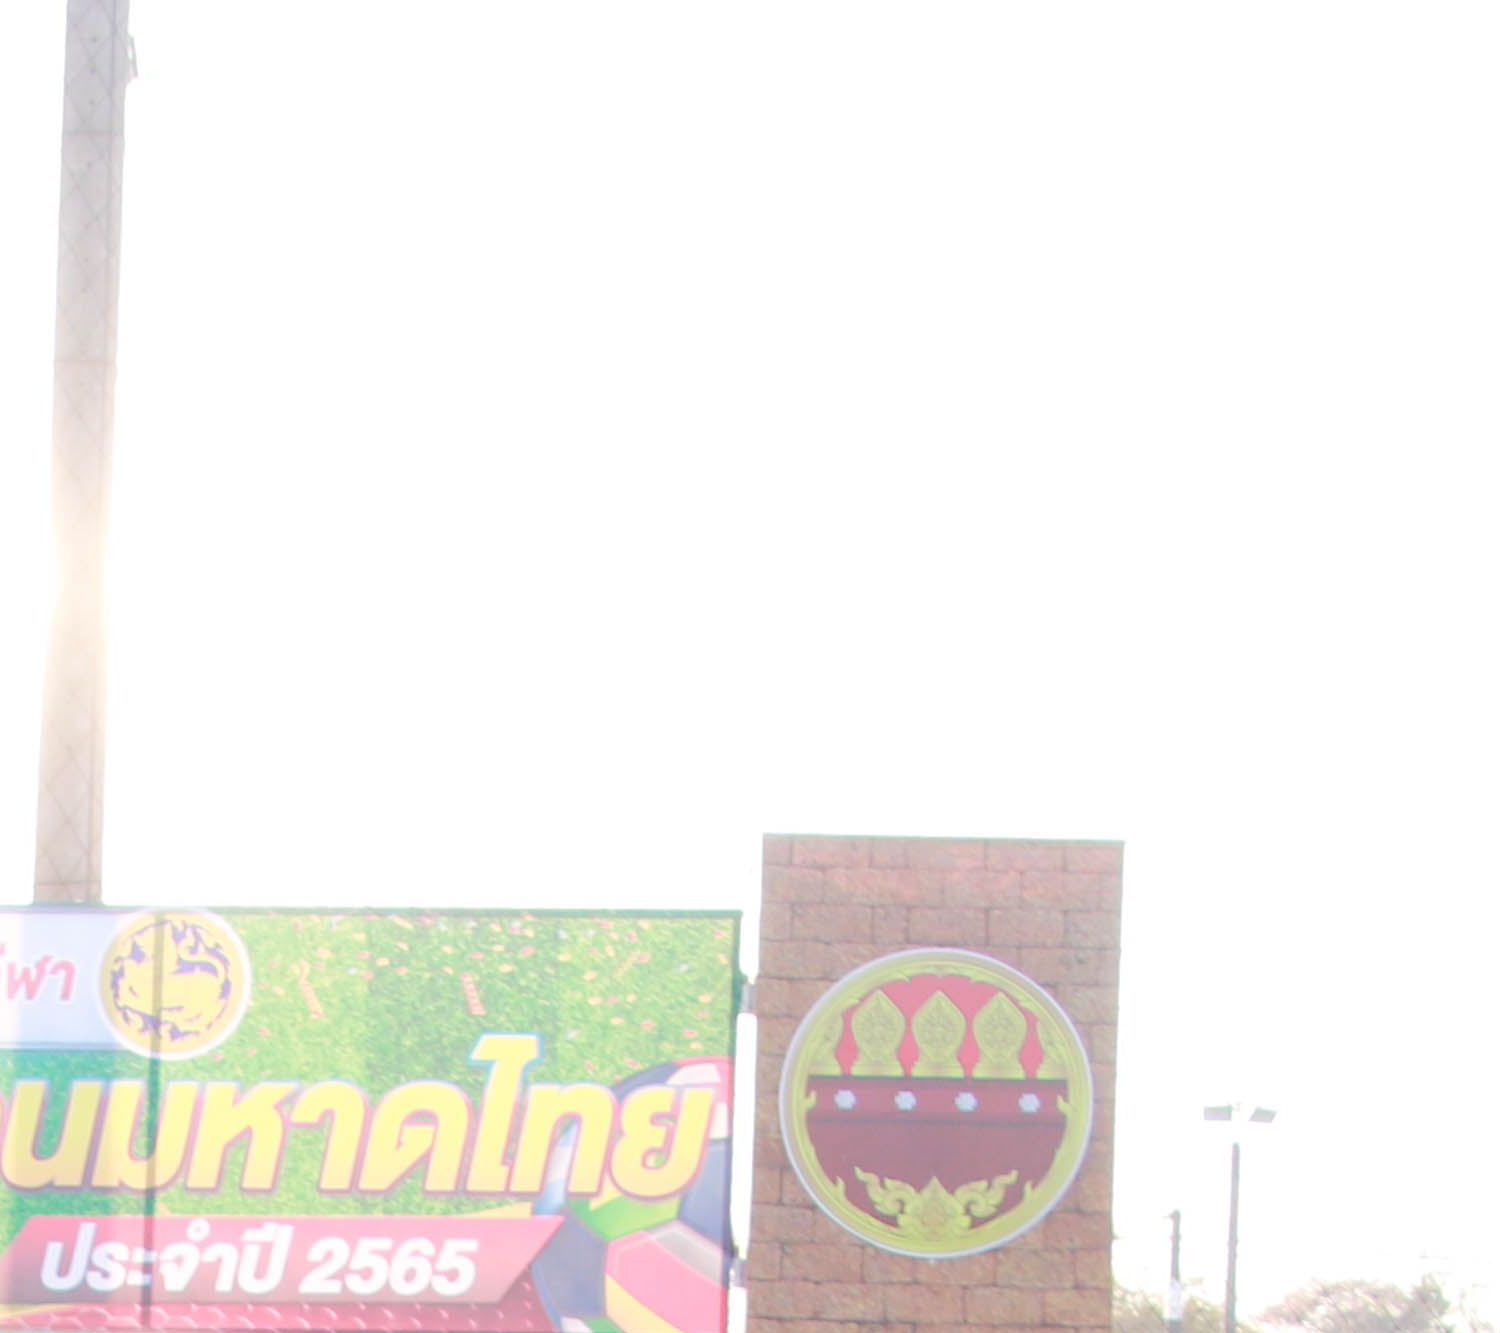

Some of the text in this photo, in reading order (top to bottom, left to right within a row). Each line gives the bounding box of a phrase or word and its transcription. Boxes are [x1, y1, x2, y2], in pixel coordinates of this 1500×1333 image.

[38, 1218, 292, 1298] ประจำปี
[298, 1237, 480, 1297] 2565
